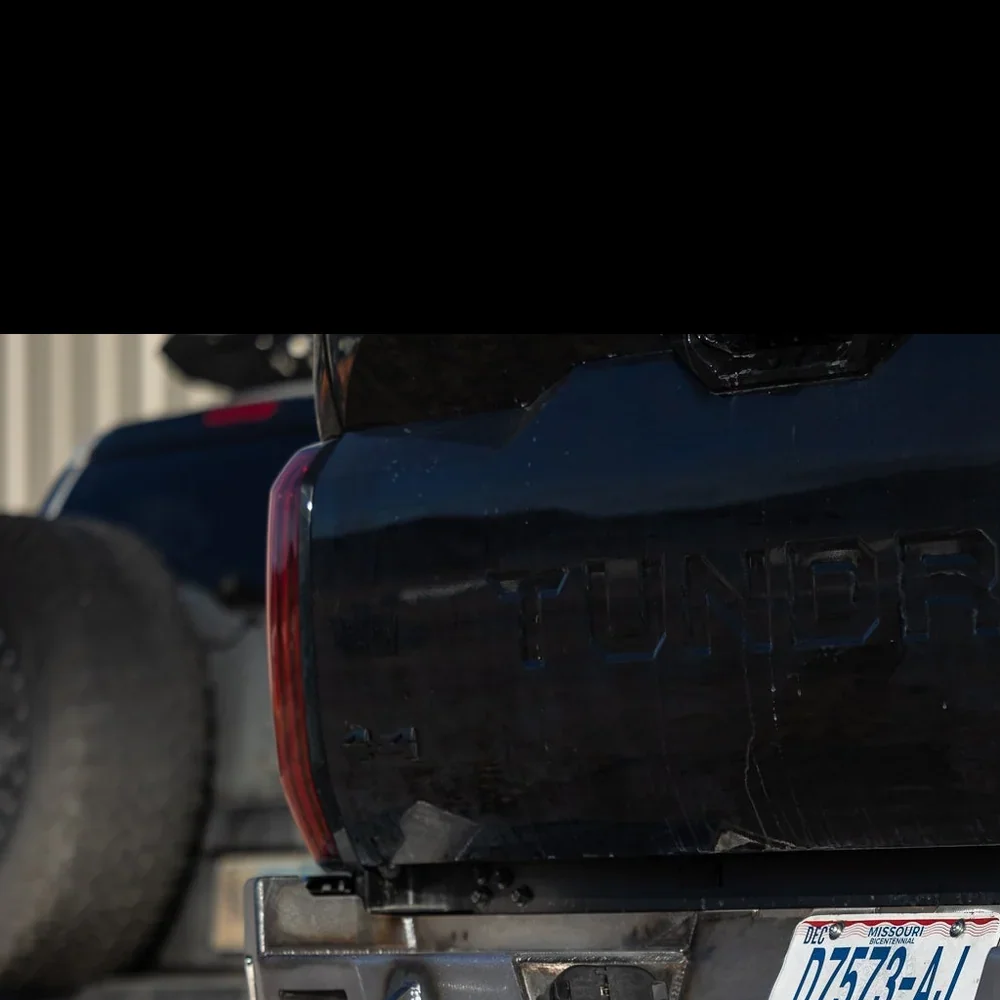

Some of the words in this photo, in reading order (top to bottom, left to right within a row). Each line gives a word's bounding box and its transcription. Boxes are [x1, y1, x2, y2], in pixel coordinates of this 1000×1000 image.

[804, 927, 828, 945] DEC
[868, 926, 924, 937] MISSOURI
[869, 937, 915, 945] BICENTENNIAL
